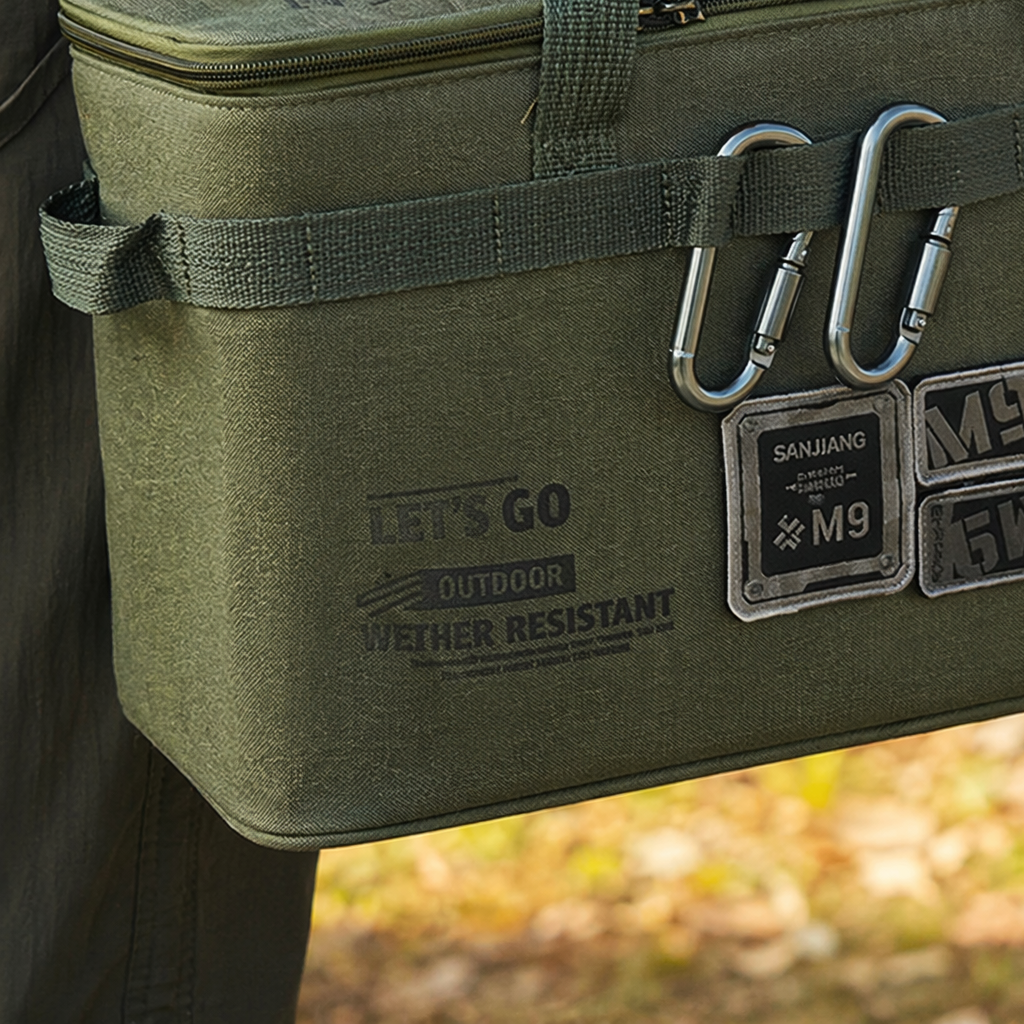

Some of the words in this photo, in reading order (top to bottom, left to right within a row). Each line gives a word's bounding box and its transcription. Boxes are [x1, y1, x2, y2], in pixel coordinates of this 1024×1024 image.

[773, 430, 867, 464] SANJIANG
[368, 494, 490, 546] LET'S
[502, 482, 571, 534] GO
[811, 500, 871, 547] M9
[437, 563, 564, 602] OUTDOOR
[361, 616, 496, 653] WETHER
[505, 586, 676, 645] RESISTANT
